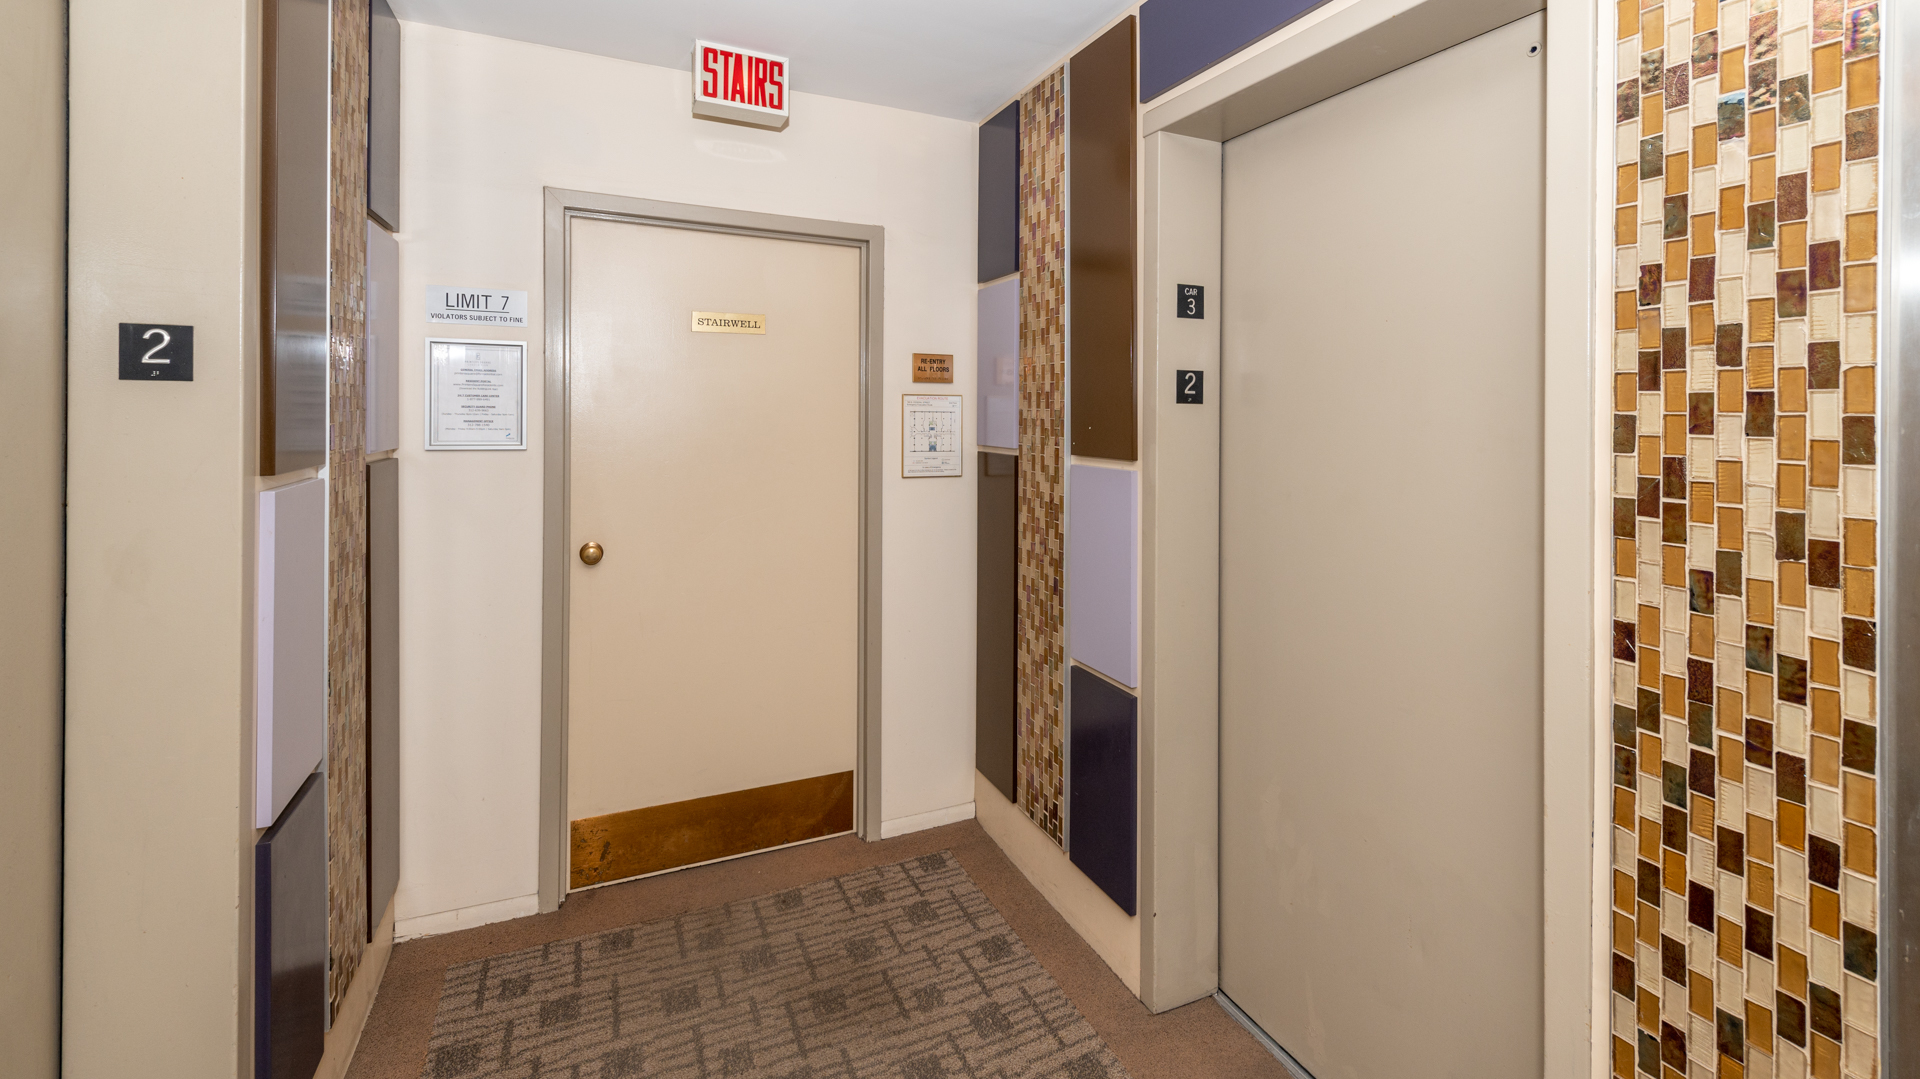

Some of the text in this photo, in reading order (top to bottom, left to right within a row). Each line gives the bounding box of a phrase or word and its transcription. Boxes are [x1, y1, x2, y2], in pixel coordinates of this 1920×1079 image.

[703, 47, 783, 110] STAIRS
[1184, 287, 1198, 296] CAR
[446, 293, 510, 310] LIMIT 7
[1186, 298, 1196, 315] 3
[698, 318, 760, 328] STAIRWELL
[141, 328, 170, 364] 2
[1184, 372, 1196, 394] 2
